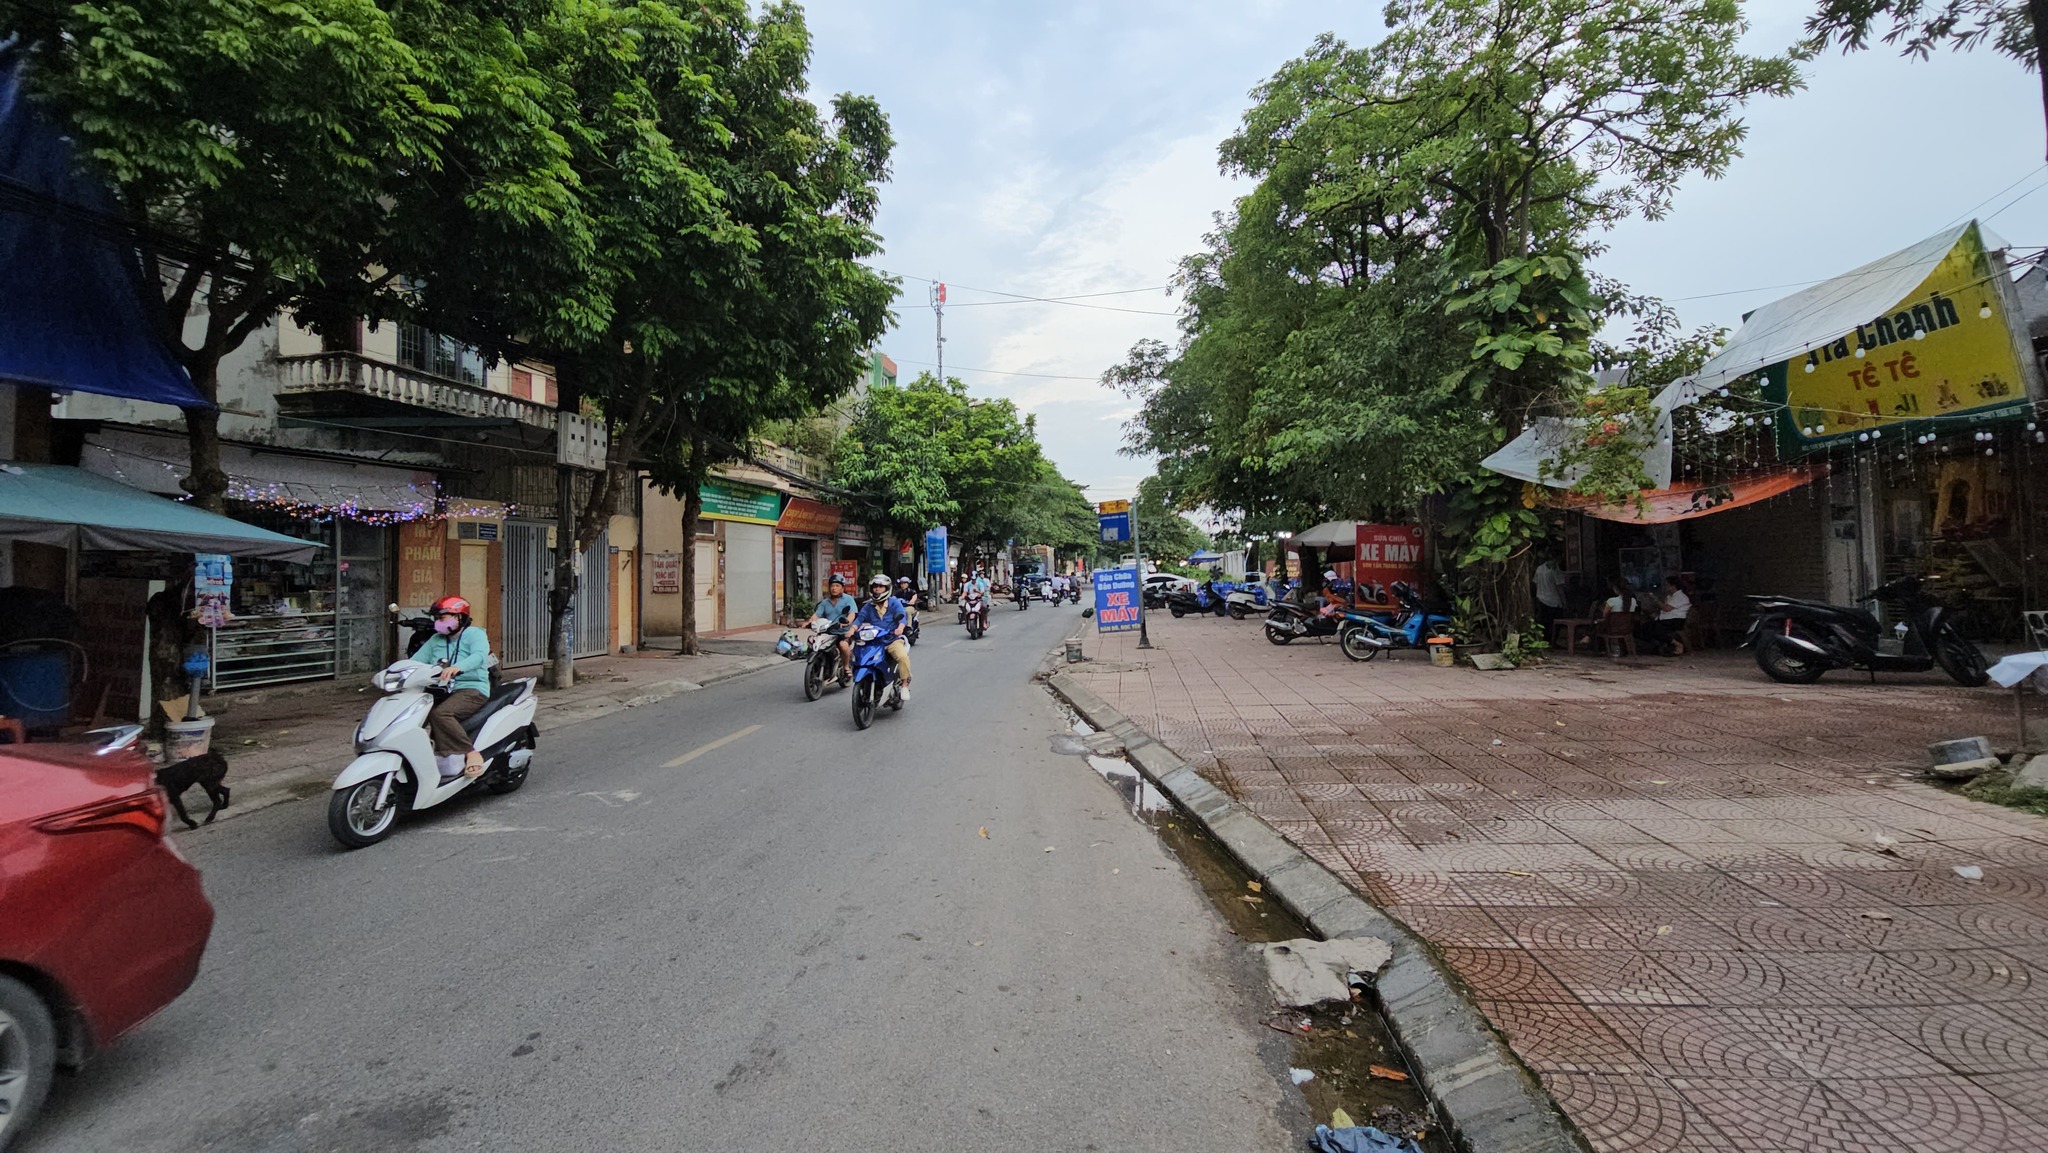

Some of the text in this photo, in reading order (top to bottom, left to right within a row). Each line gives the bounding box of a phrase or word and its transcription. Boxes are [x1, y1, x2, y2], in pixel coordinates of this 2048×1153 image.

[1847, 350, 1920, 391] TÊ TÊ
[404, 541, 441, 560] PHẨM
[1360, 542, 1420, 562] XE MÁY
[412, 566, 434, 583] GIÁ
[1106, 592, 1130, 607] XE
[1100, 605, 1139, 624] MÁY
